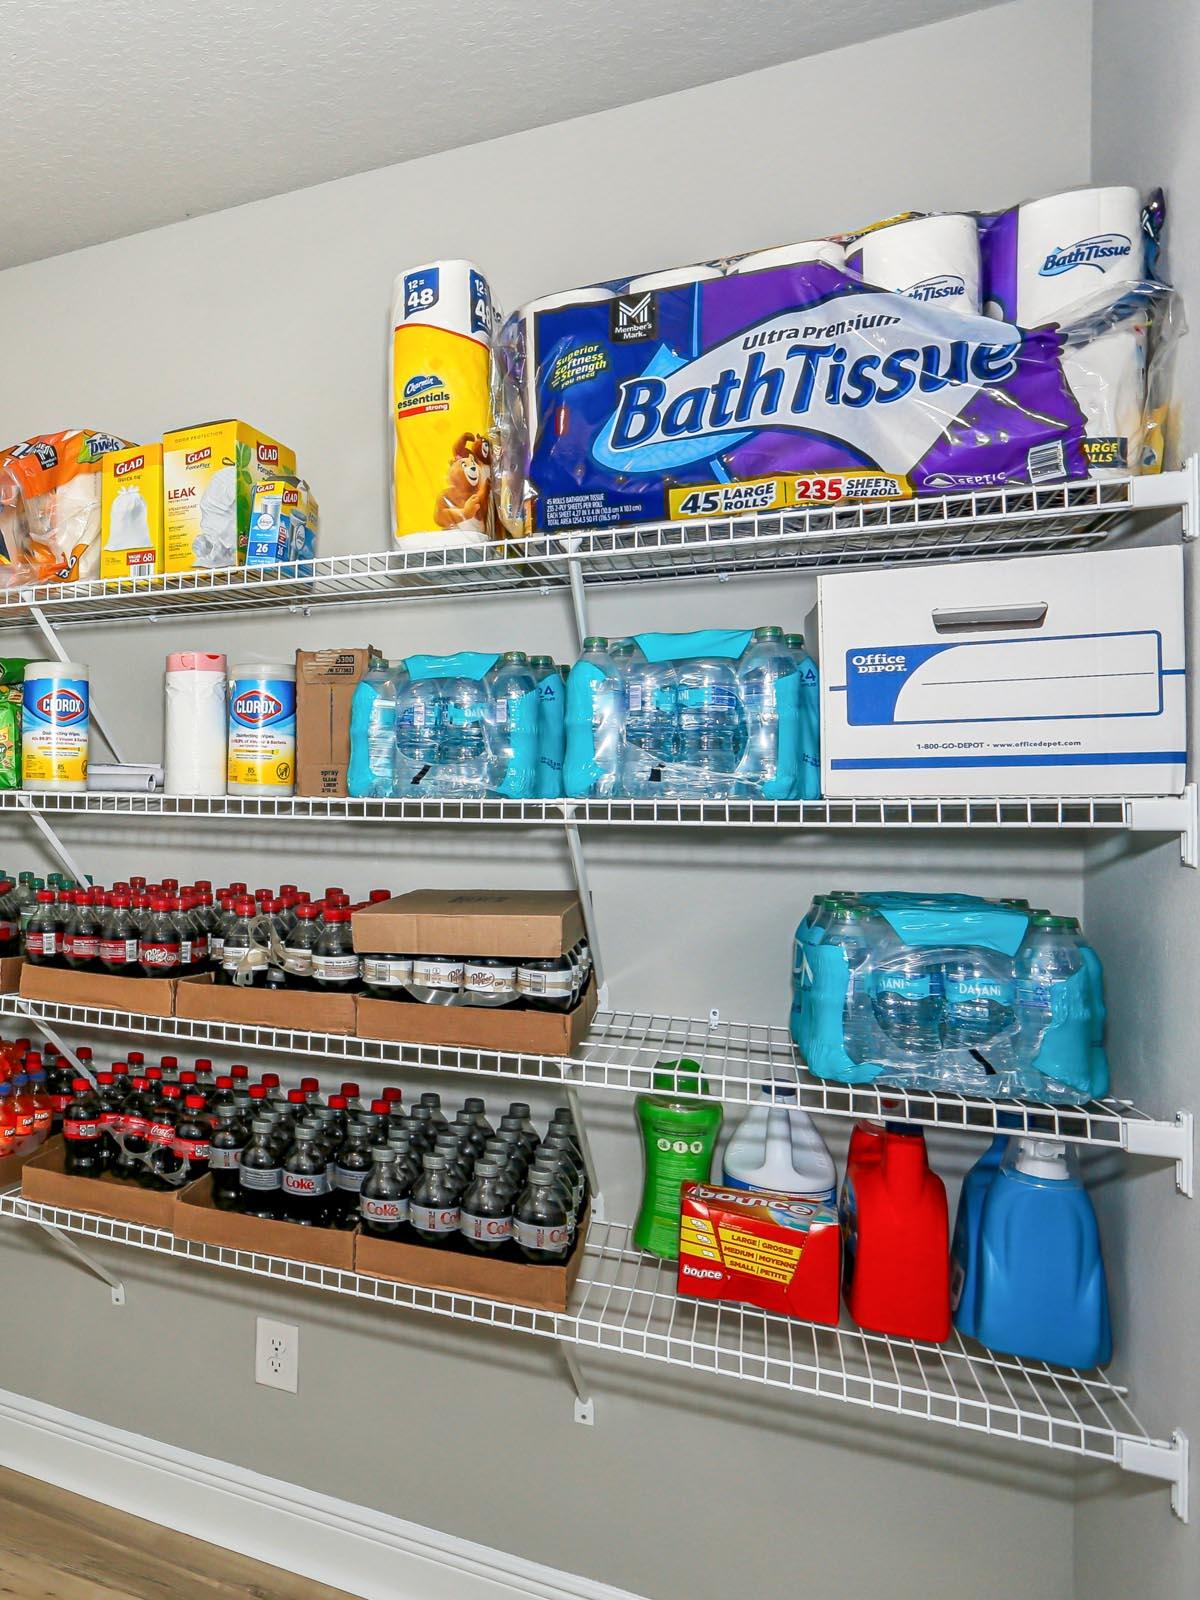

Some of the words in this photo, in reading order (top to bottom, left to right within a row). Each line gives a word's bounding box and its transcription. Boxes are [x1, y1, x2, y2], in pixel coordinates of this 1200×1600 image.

[408, 288, 434, 307] 48
[615, 322, 652, 334] Member's
[742, 326, 799, 350] Ultra
[803, 313, 901, 339] Premium
[556, 345, 599, 368] Superior
[555, 353, 604, 379] Softness
[560, 360, 607, 382] Strength
[576, 371, 595, 382] need
[397, 392, 450, 409] essentials
[425, 403, 448, 411] strong
[258, 445, 278, 461] GLAD
[1082, 442, 1118, 453] ARGE
[187, 449, 211, 463] GLAD
[116, 457, 144, 475] GLAD
[257, 485, 274, 493] GLAD
[723, 481, 775, 500] LARGE
[797, 478, 843, 501] 235
[846, 478, 896, 490] SHEETS
[168, 486, 196, 500] LEAK
[283, 490, 298, 503] GLAD
[846, 488, 869, 497] PER
[870, 487, 900, 497] ROLL
[680, 492, 721, 514] 45
[255, 543, 269, 553] 26
[143, 553, 153, 562] 68
[852, 654, 906, 665] Office
[236, 700, 276, 715] CLOROX
[916, 742, 985, 750] 1-800-GO-DEPOT
[992, 740, 1082, 749] www.officedepot.com
[285, 1175, 315, 1190] Coke
[366, 1201, 399, 1217] Coke
[699, 1187, 814, 1216] bounce
[723, 1245, 755, 1260] MEDIUM
[731, 1234, 758, 1246] LARGE
[761, 1242, 794, 1256] GROSSE
[682, 1264, 723, 1280] bounce
[729, 1260, 756, 1273] SMALL
[759, 1268, 788, 1281] PETITE
